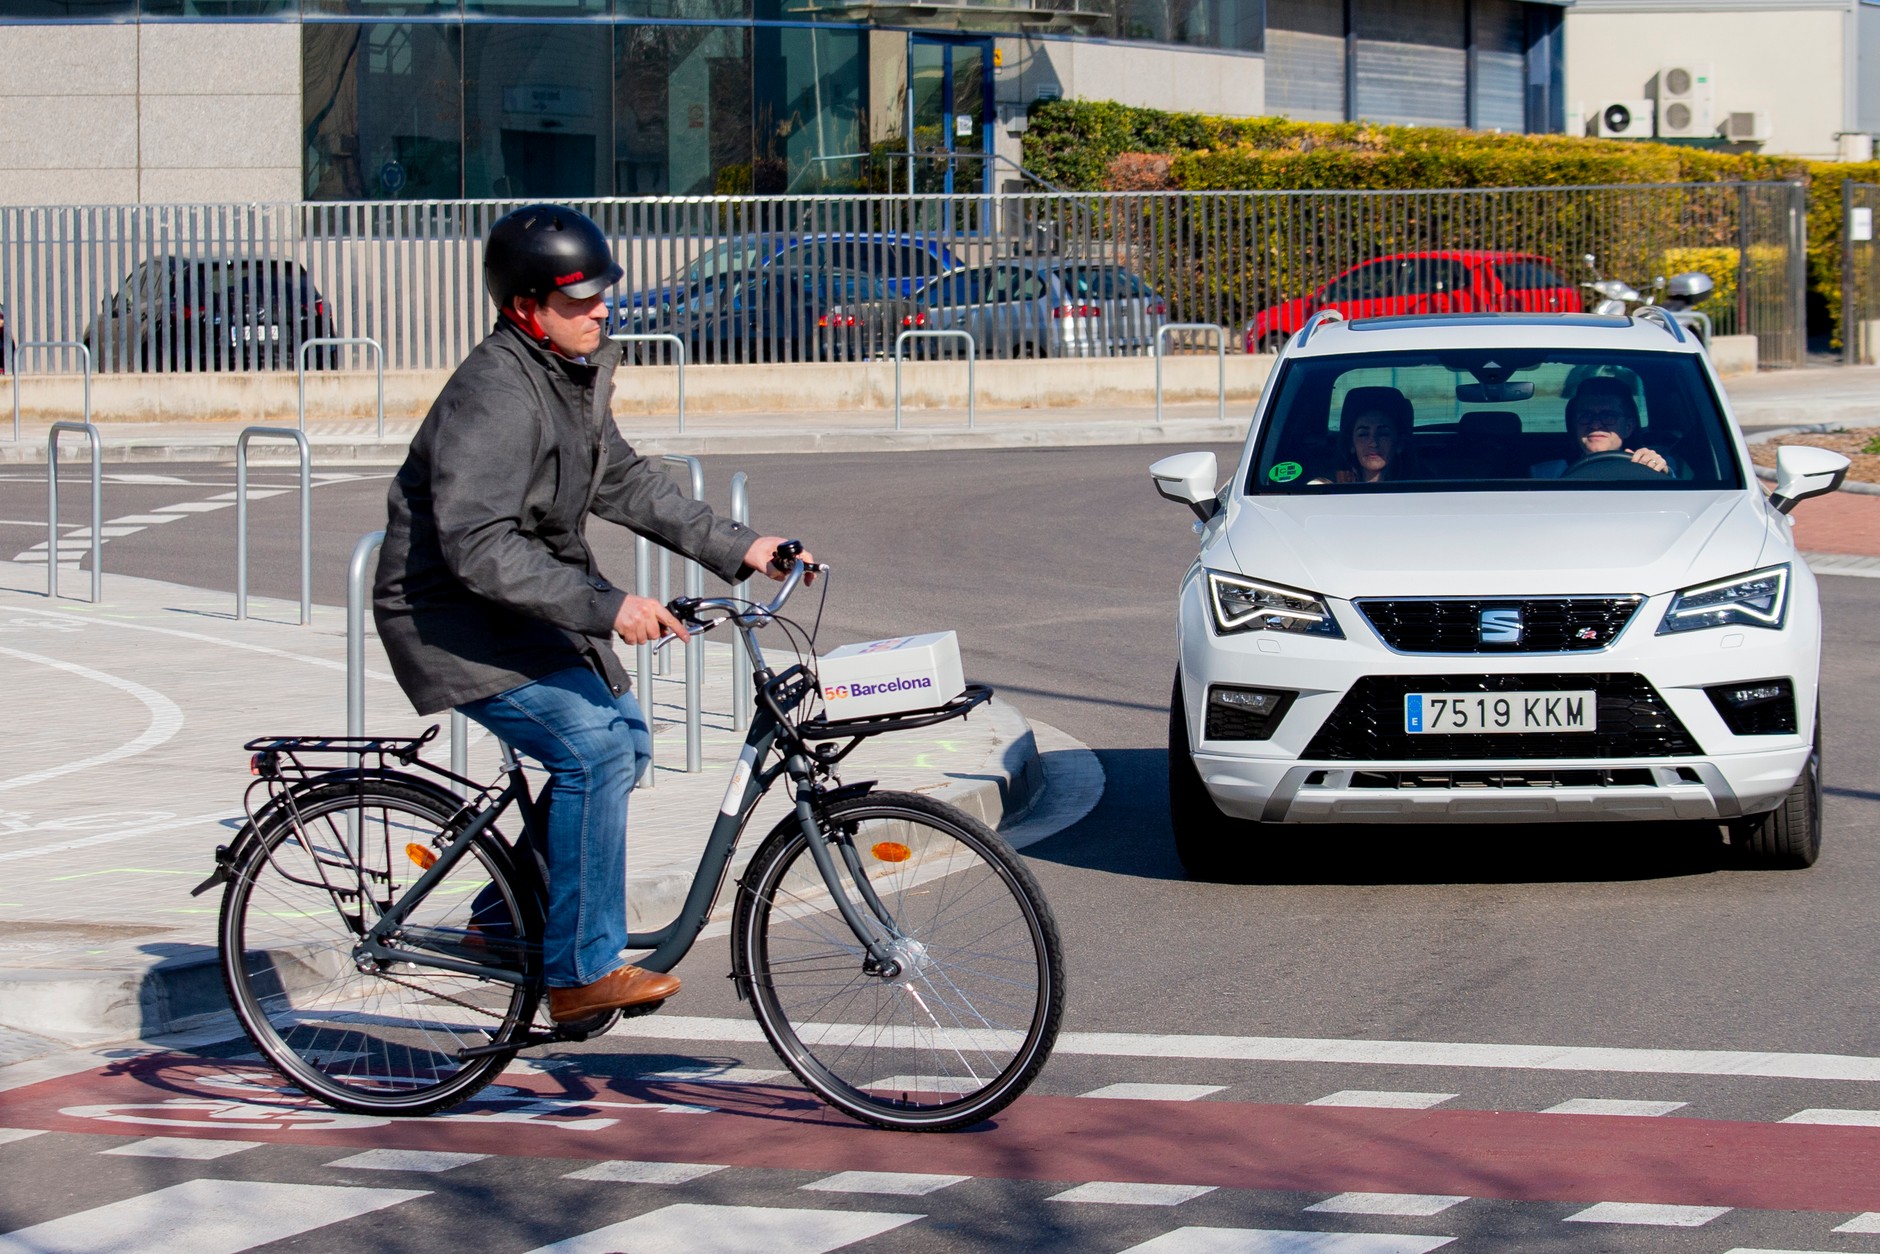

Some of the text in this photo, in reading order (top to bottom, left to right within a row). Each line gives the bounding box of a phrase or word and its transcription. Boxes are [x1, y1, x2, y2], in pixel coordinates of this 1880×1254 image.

[824, 677, 932, 701] 5G Barcelona
[1412, 717, 1418, 726] E
[1430, 697, 1584, 728] 7519 KKM
